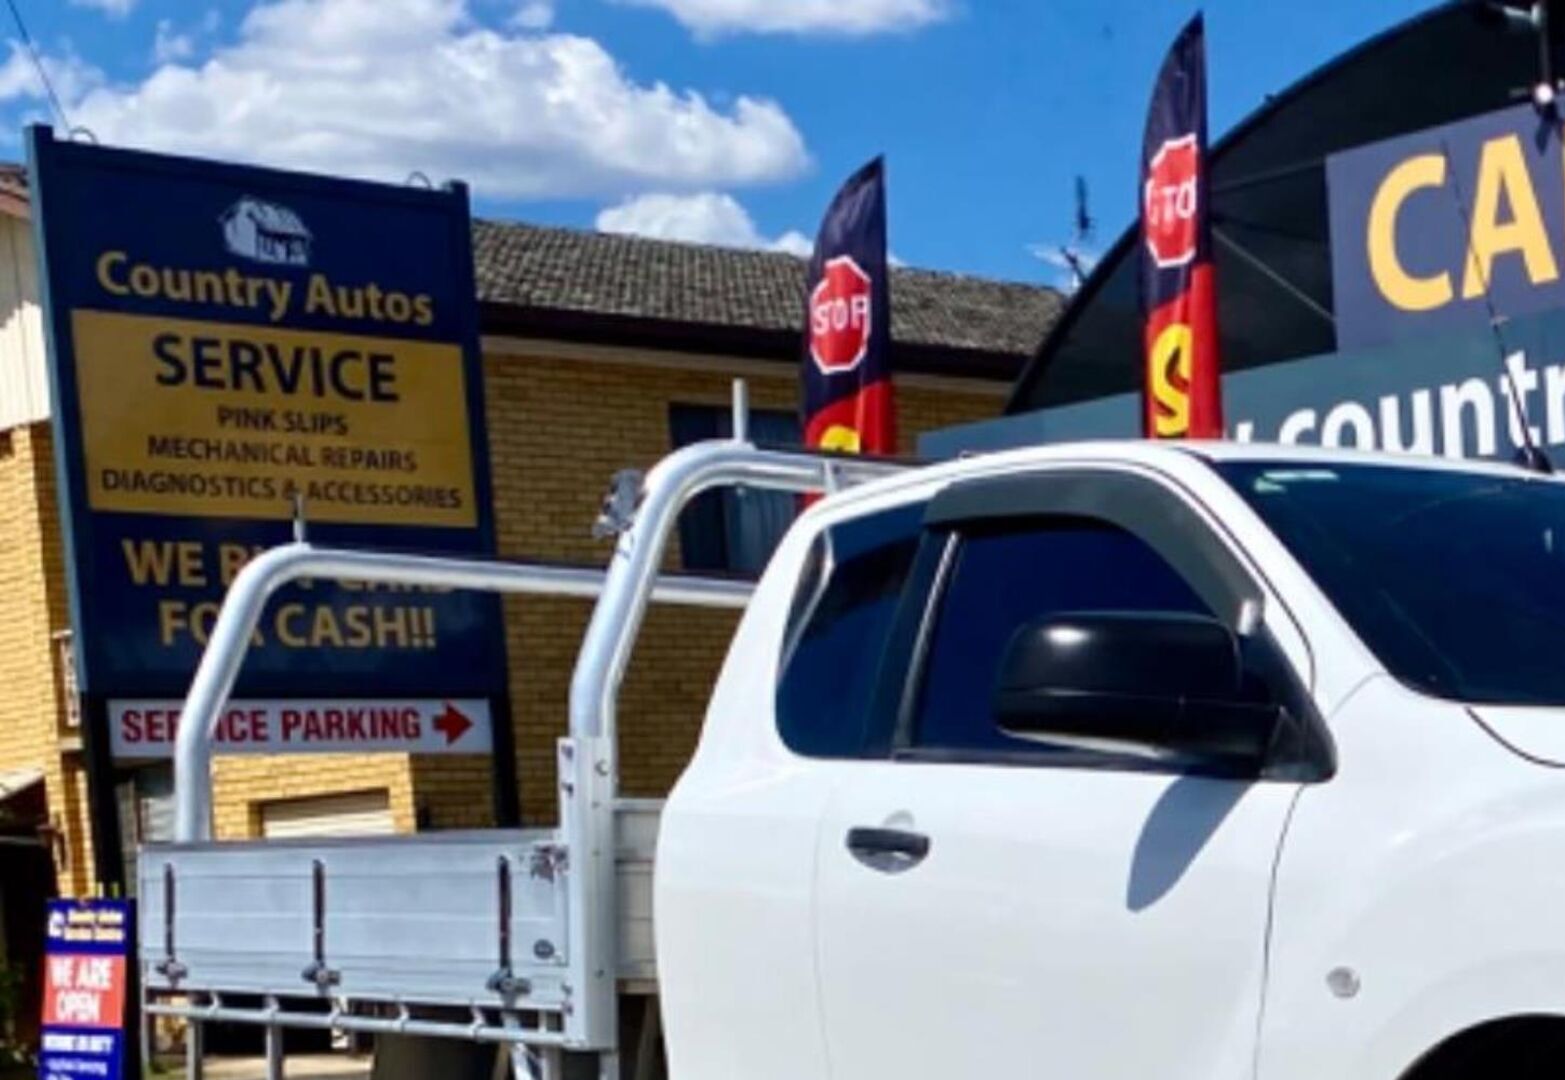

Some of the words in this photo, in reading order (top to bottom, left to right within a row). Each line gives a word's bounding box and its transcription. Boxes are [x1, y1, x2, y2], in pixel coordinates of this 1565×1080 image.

[97, 251, 292, 321] Country
[304, 273, 434, 325] Autos
[153, 332, 399, 402] SERVICE
[217, 405, 278, 432] PINK
[283, 411, 349, 436] SLIPS
[147, 435, 316, 468] MECHANICAL
[321, 446, 418, 473] REPAIRS
[101, 469, 277, 499] DIAGNOSTICS
[307, 480, 463, 510] ACCESSORIES
[121, 539, 207, 587] WE
[158, 601, 264, 648] FO
[276, 604, 437, 649] CASH!!
[121, 709, 269, 743] SEICE
[281, 708, 422, 742] PARKING
